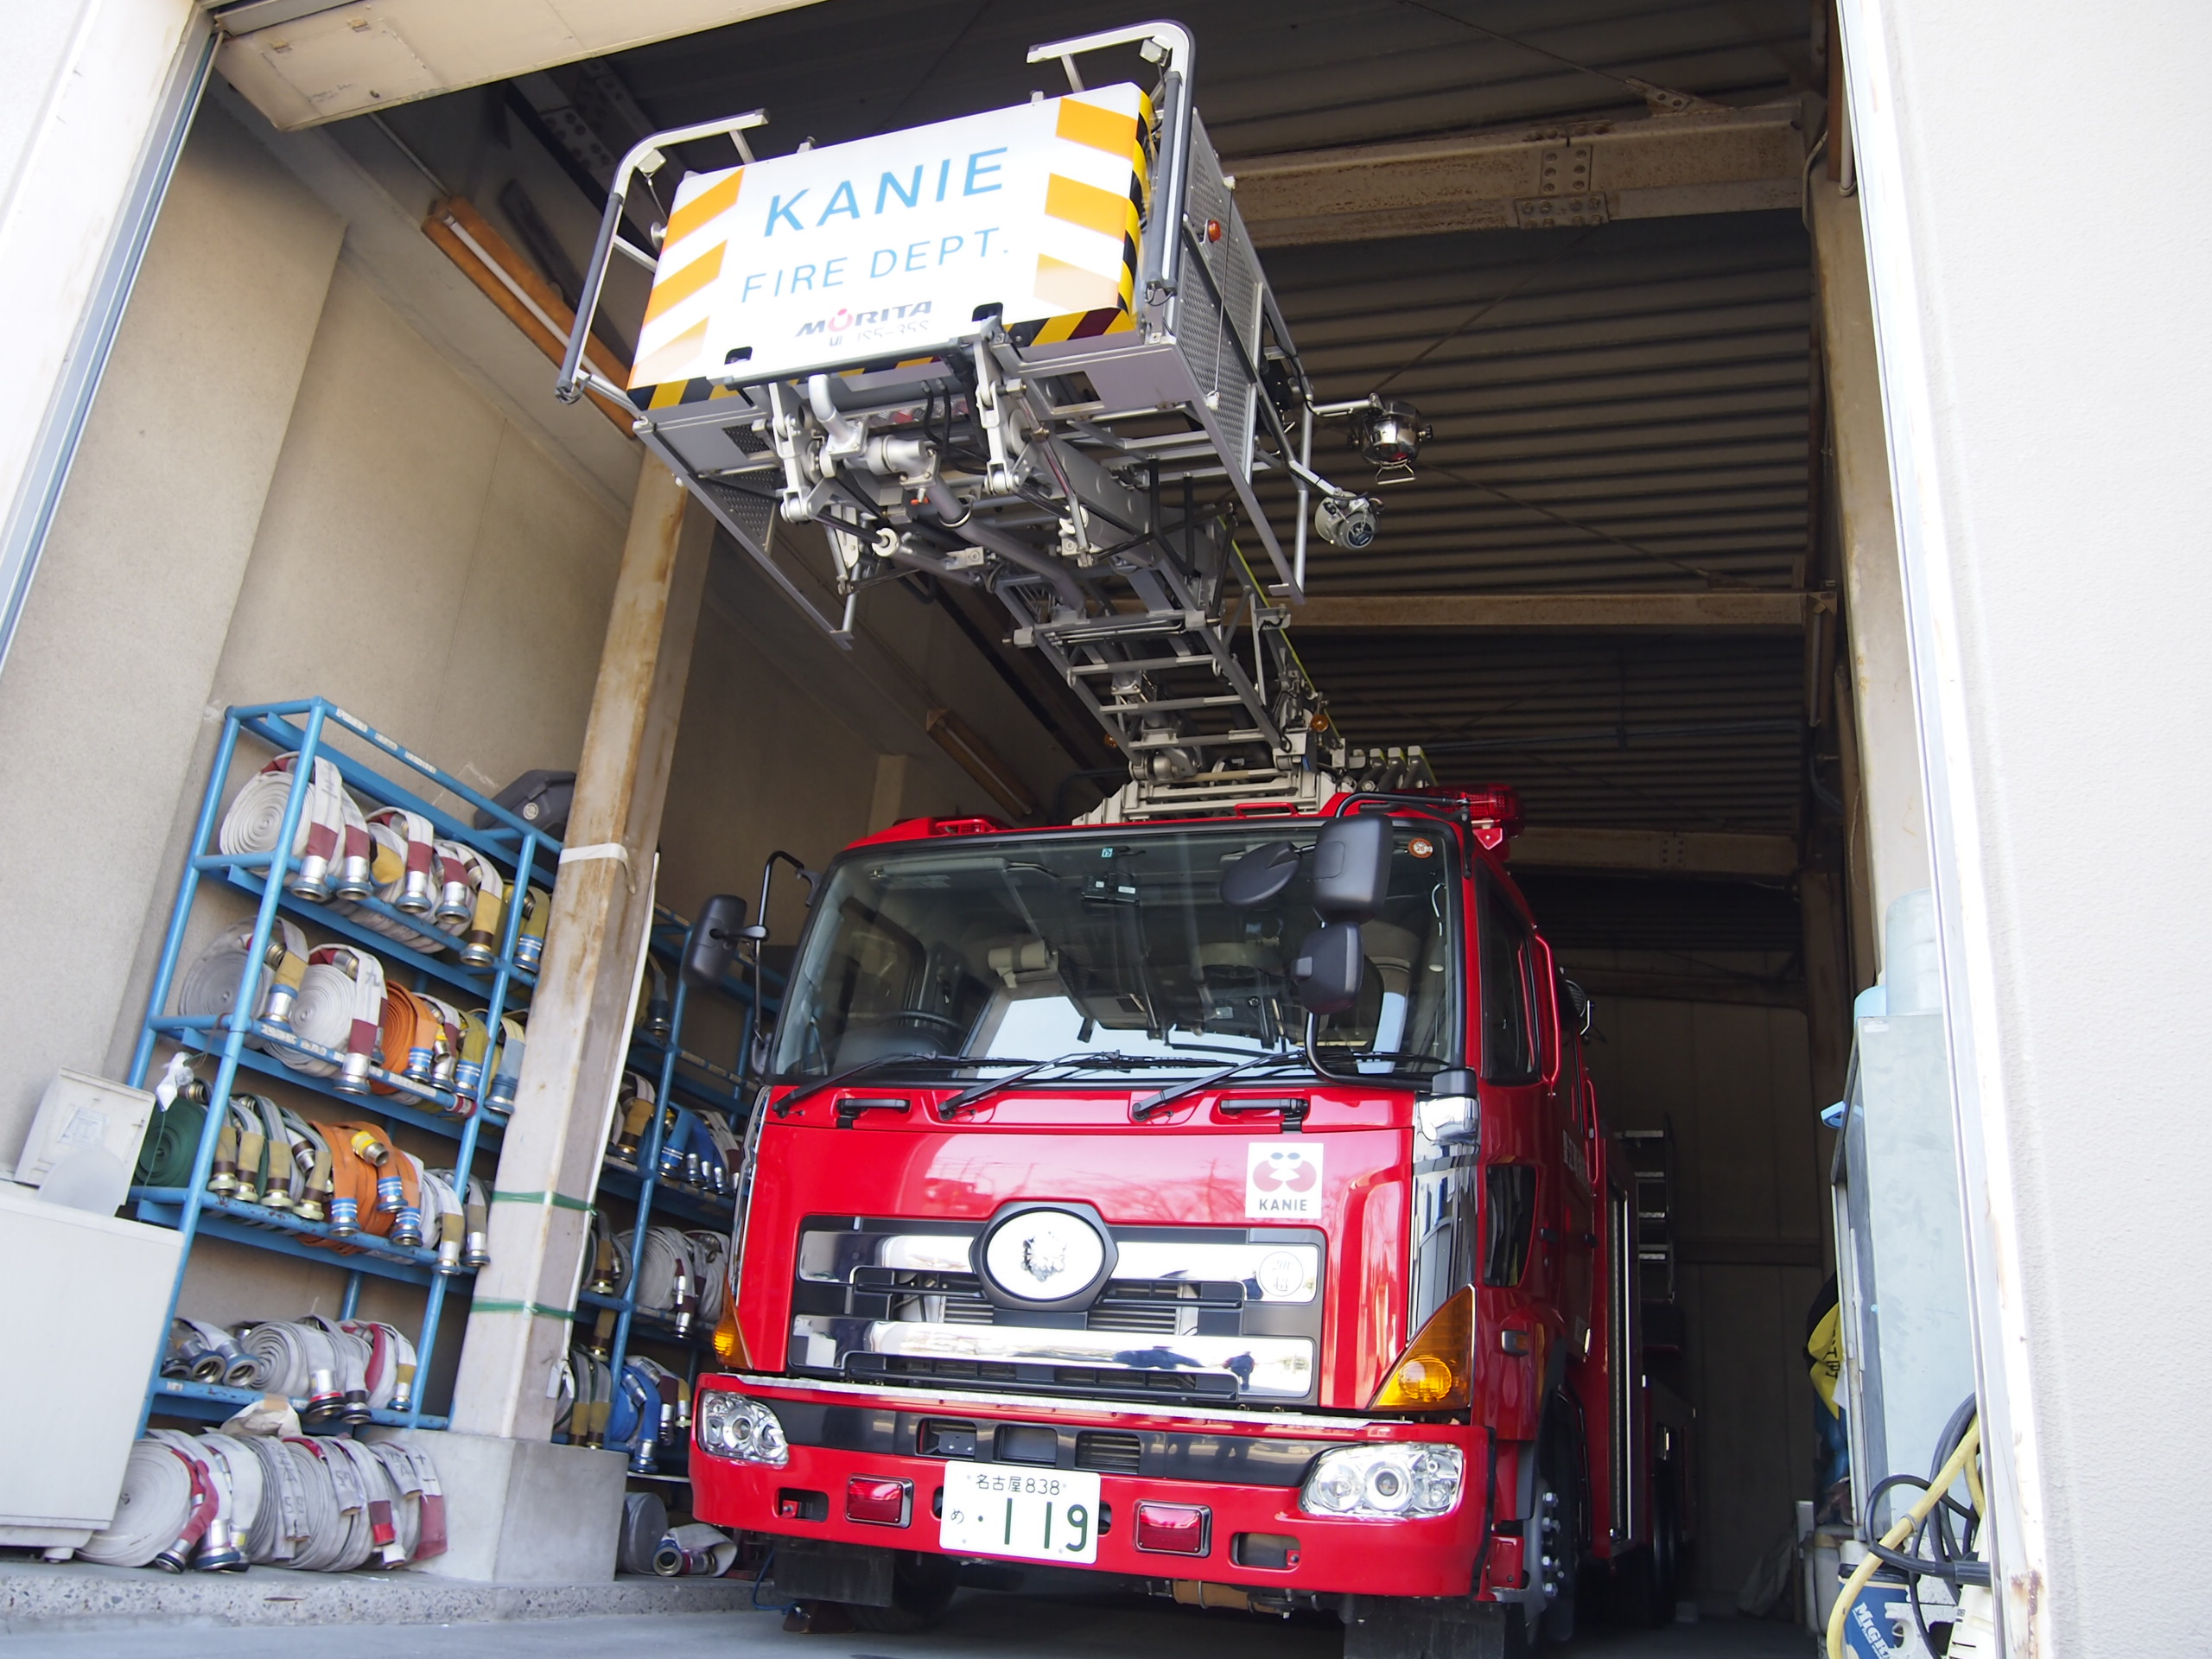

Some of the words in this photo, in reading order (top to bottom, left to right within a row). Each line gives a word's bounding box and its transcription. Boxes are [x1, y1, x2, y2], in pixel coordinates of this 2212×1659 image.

[764, 146, 1007, 237] KANIE
[741, 257, 848, 303] FIRE
[870, 227, 1008, 278] DEPT.
[795, 301, 932, 338] MORITA
[1259, 1198, 1307, 1211] KANIE
